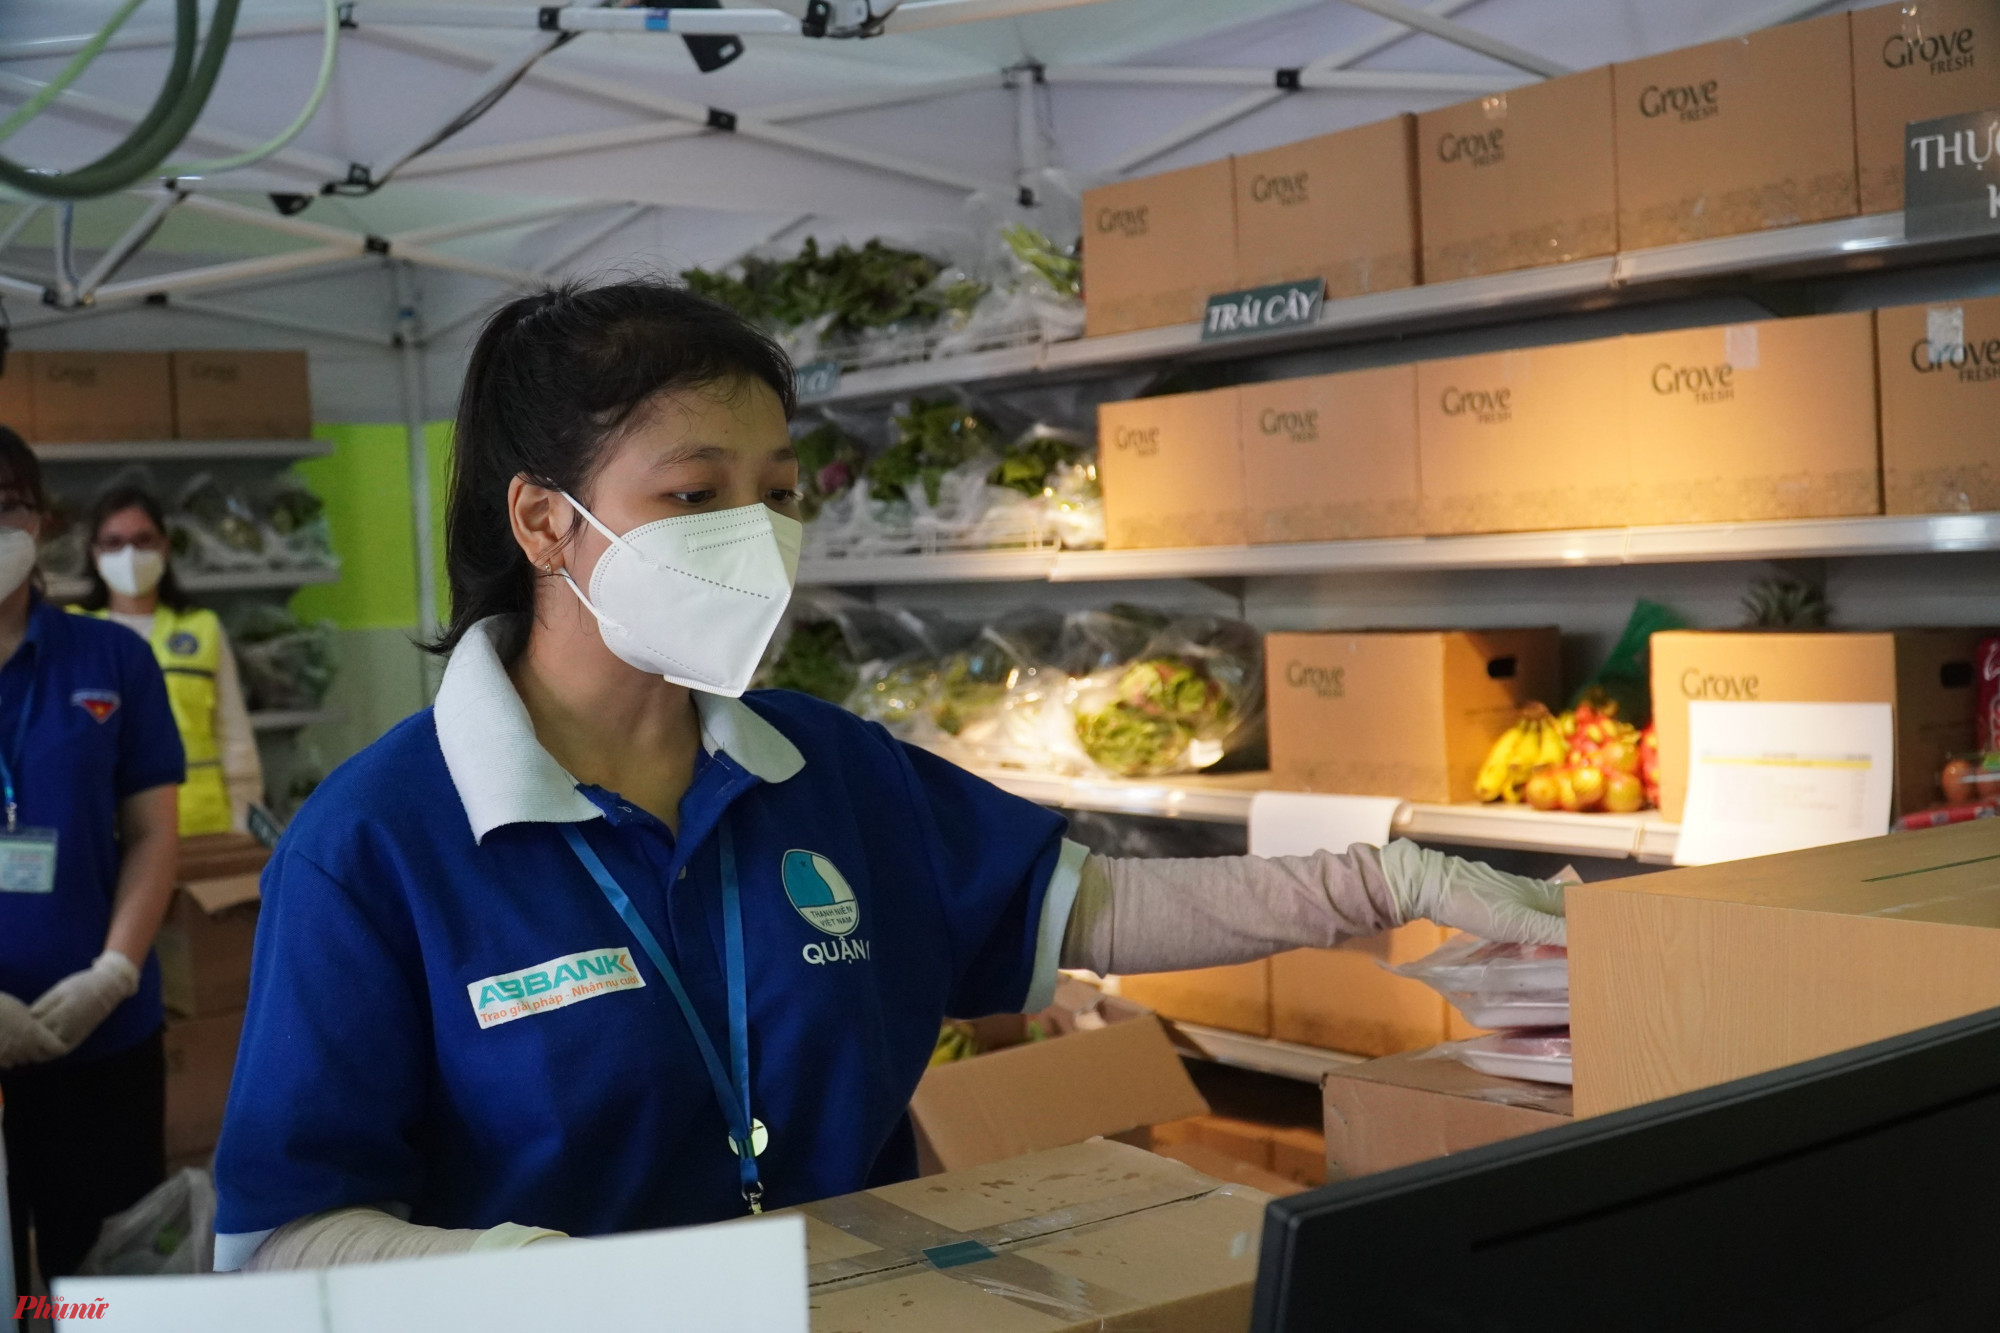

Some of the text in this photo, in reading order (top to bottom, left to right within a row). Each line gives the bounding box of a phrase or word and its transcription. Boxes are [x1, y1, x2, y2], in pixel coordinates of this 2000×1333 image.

[1883, 28, 1974, 69] Grove
[1930, 54, 1974, 75] FRESH
[1639, 80, 1717, 118] Grove
[1437, 128, 1504, 162] Grove
[1911, 121, 2000, 171] THỰ
[1251, 171, 1309, 203] Grove
[1208, 288, 1319, 332] TRÁI CÂY
[1912, 338, 2000, 374] Grove
[1651, 362, 1734, 396] Grove
[1440, 386, 1512, 417] Grove
[1259, 407, 1319, 435] Grove
[1284, 660, 1345, 688] Grove
[1681, 667, 1760, 699] Grove
[837, 916, 853, 925] NAM
[803, 936, 866, 965] QUẬN
[478, 954, 633, 1010] ABBANK
[480, 1010, 507, 1024] Trao
[510, 1000, 532, 1018] giải
[533, 993, 564, 1012] pháp
[572, 981, 603, 997] Nhận
[605, 979, 618, 990] nụ
[620, 975, 639, 986] cười
